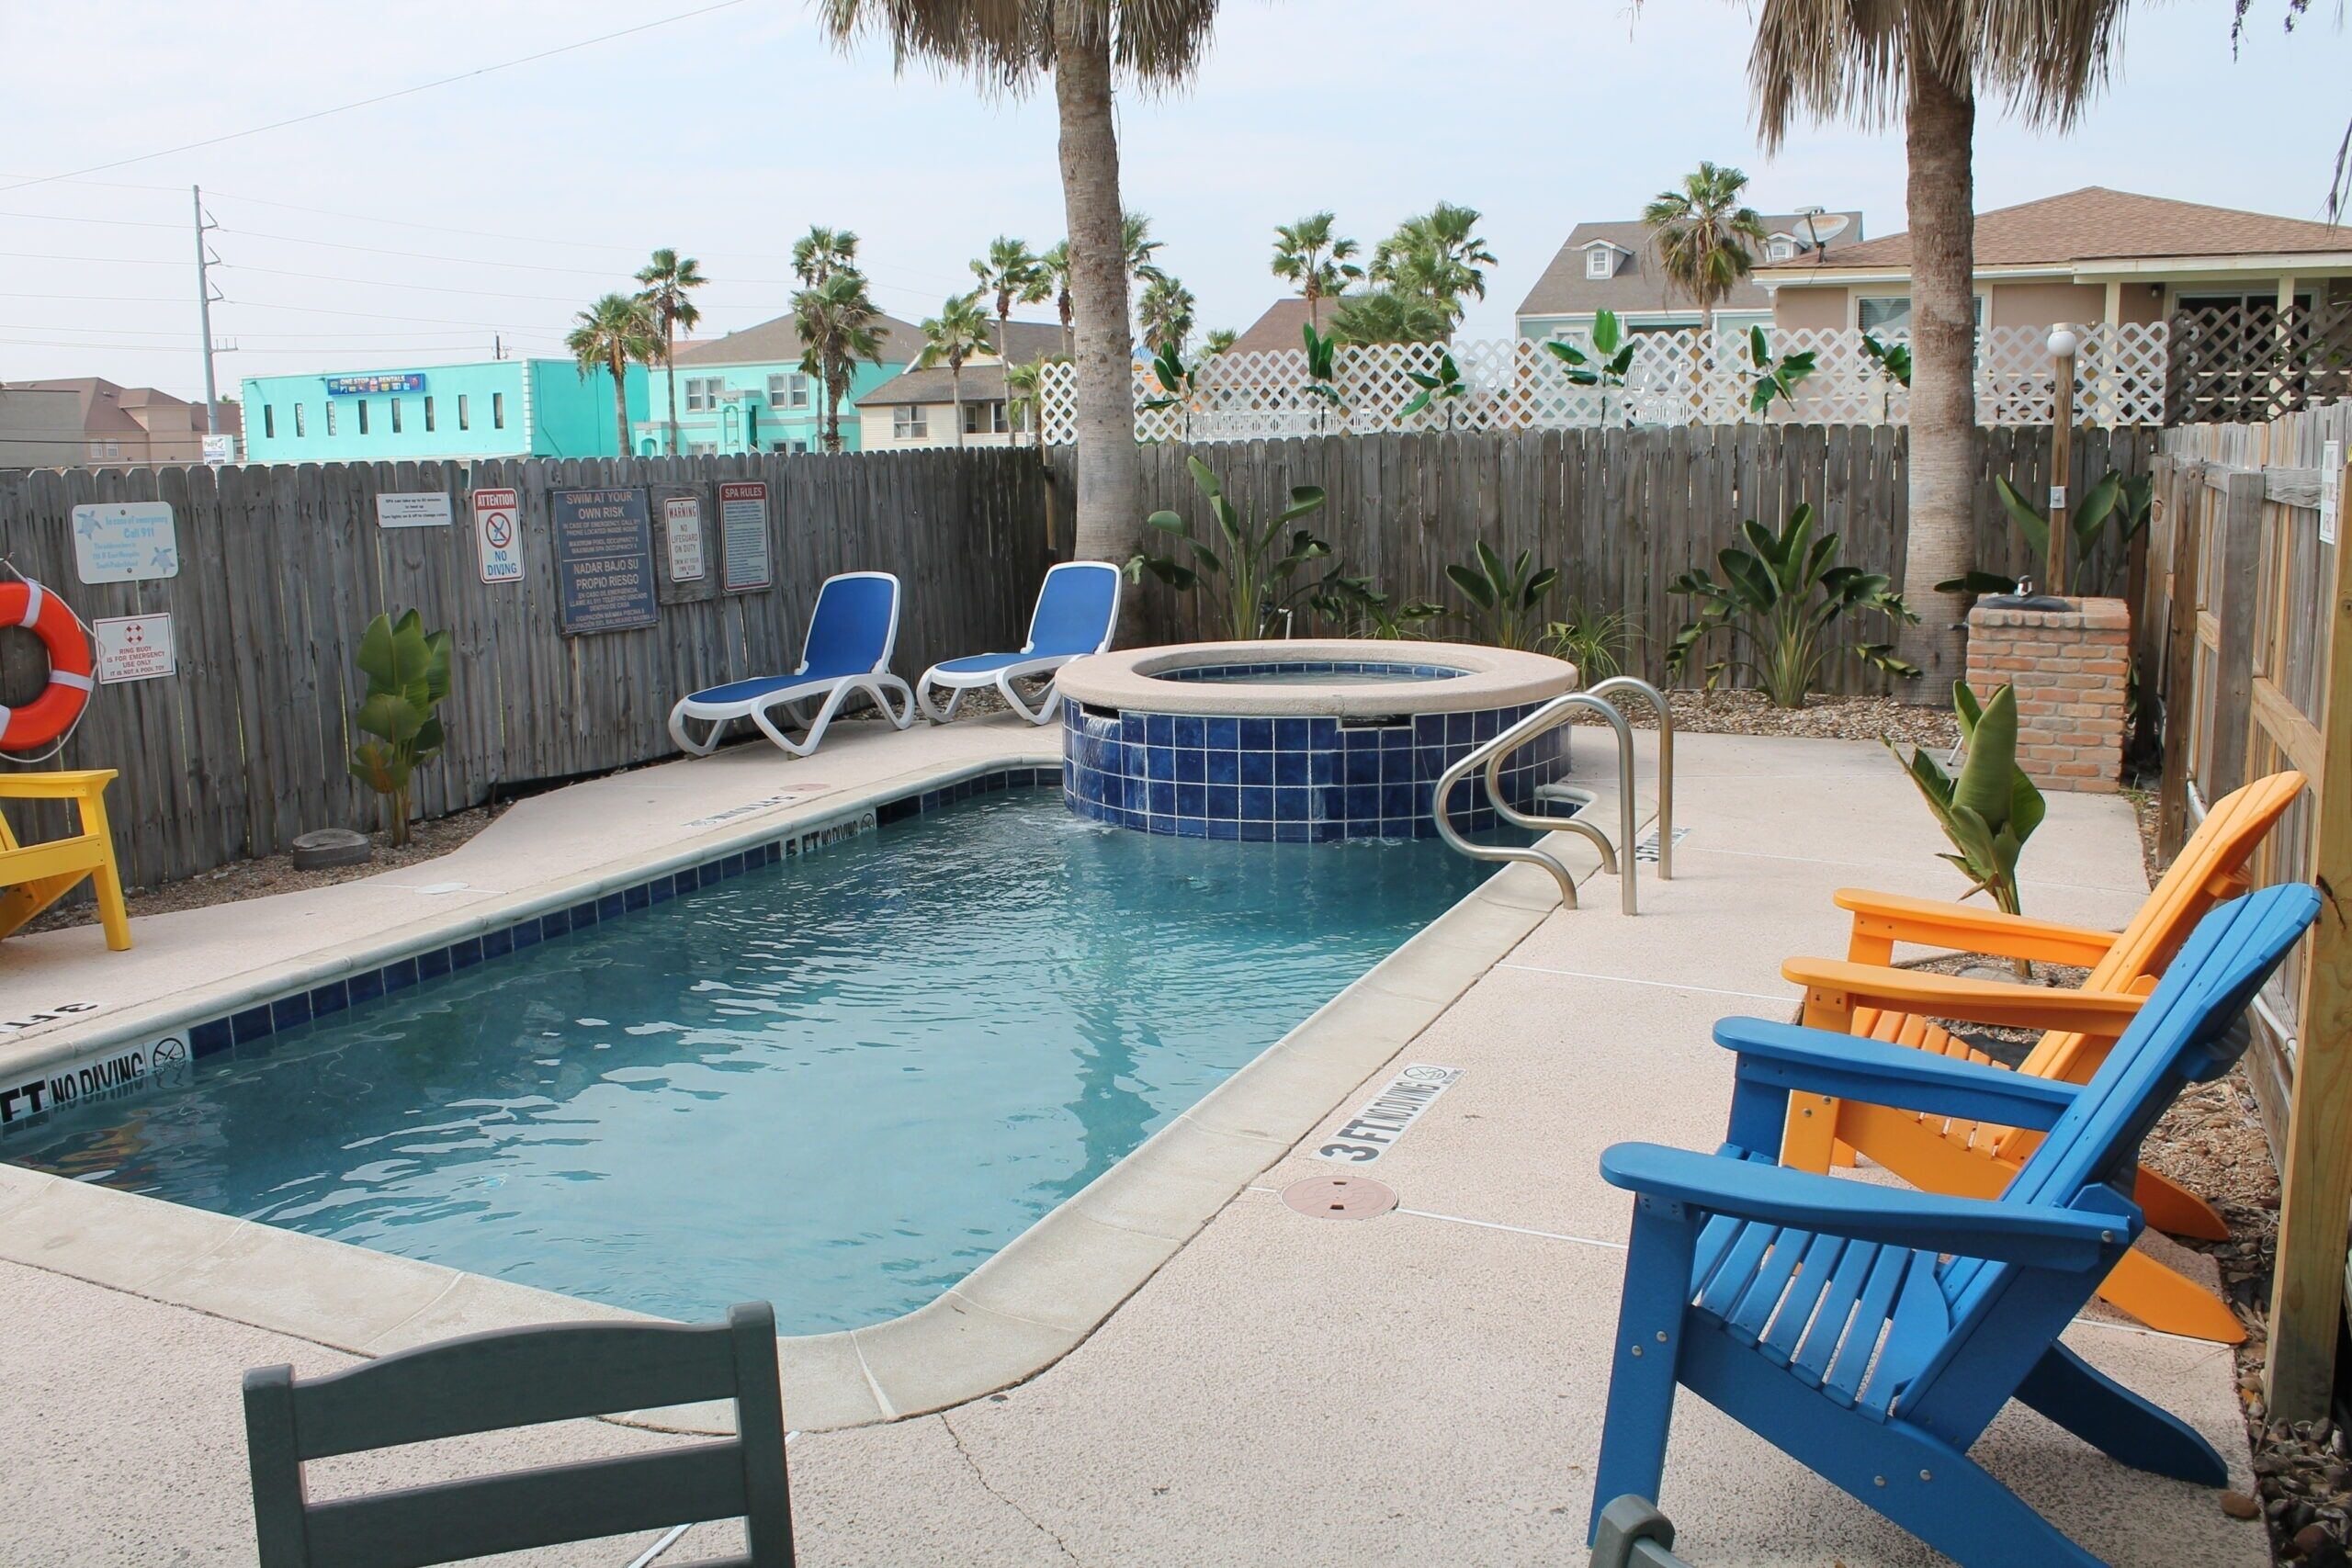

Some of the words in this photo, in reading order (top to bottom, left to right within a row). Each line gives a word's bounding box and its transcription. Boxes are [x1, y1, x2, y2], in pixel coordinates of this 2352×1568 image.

[566, 493, 592, 505] SWIM
[594, 492, 605, 503] AT
[606, 491, 633, 502] YOUR
[725, 488, 739, 498] SPA
[740, 487, 762, 497] RULES
[477, 493, 514, 507] ATTENTION
[578, 507, 601, 520] OWN
[603, 506, 625, 518] RISK
[668, 506, 696, 519] WARNING
[124, 527, 139, 538] Call
[140, 527, 155, 537] 911
[680, 524, 688, 532] NO
[671, 533, 698, 544] LIFEGUARD
[683, 544, 696, 552] DUTY
[494, 550, 507, 562] NO
[487, 563, 517, 576] DIVING
[573, 562, 603, 575] NADAR
[605, 560, 626, 572] BAJO
[628, 558, 639, 570] SU
[575, 576, 607, 590] PROPIO
[609, 574, 639, 587] RIESGO
[628, 592, 648, 601] UBICADO
[129, 651, 165, 661] EMERGENCY
[821, 829, 832, 846] NO
[832, 820, 858, 842] DIVING
[53, 1003, 98, 1013] 3
[51, 1073, 78, 1105] NO
[79, 1052, 145, 1096] DIVING
[1374, 1082, 1440, 1111] DIVING
[1362, 1108, 1413, 1123] NO
[1319, 1144, 1380, 1162] 3
